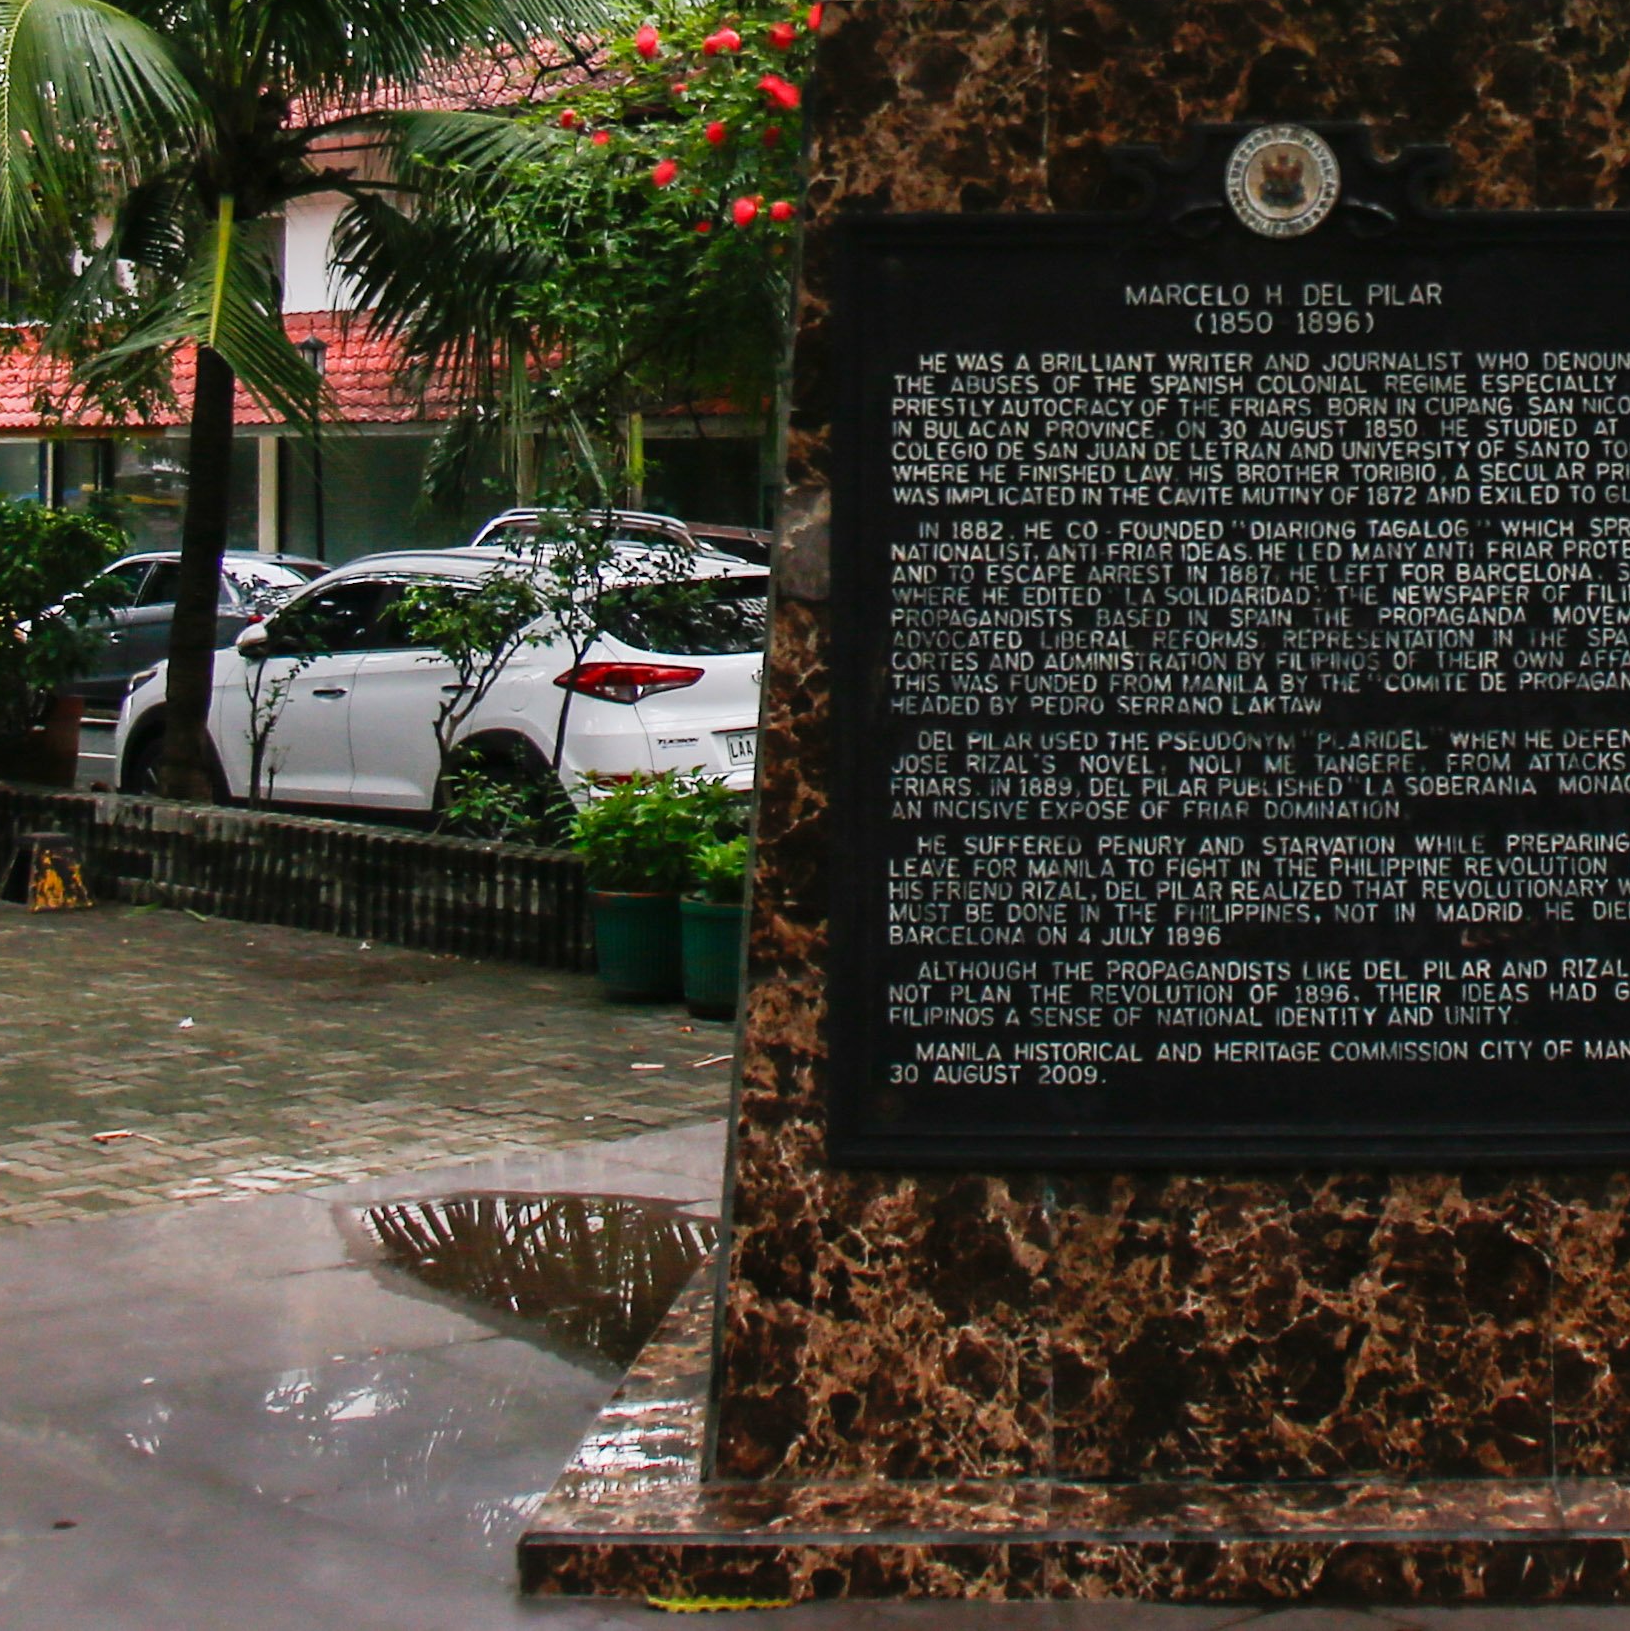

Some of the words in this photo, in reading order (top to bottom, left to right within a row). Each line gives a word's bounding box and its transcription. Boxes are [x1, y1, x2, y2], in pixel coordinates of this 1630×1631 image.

[1125, 284, 1250, 306] MARCELO
[1303, 283, 1352, 305] DEL
[1367, 283, 1443, 305] PILAR
[1296, 311, 1375, 333] 1896)
[918, 353, 948, 374] HE
[955, 353, 1005, 374] WAS
[1014, 352, 1031, 373] A
[1040, 352, 1157, 373] BRILLIANT
[1166, 352, 1254, 373] WRITER
[1264, 352, 1310, 373] AND
[1321, 351, 1463, 372] JOURNALIST
[1476, 351, 1530, 372] WHO
[893, 375, 936, 395] THE
[950, 375, 1040, 395] ABUSES
[1052, 374, 1082, 394] OF
[1093, 374, 1137, 394] THE
[1149, 374, 1244, 394] SPANISH
[1255, 373, 1368, 393] COLONIAL
[1384, 373, 1467, 393] REGIME
[1480, 373, 1617, 393] ESPECIALLY
[891, 398, 996, 418] PRIESTLY
[1000, 397, 1135, 417] AUTOCRACY
[1139, 397, 1169, 417] OF
[1326, 396, 1388, 416] BORN
[1395, 396, 1417, 416] IN
[1527, 396, 1574, 416] SAN
[892, 420, 913, 440] IN
[923, 420, 1030, 440] BULACAN
[1218, 419, 1248, 439] 30
[1259, 419, 1348, 439] AUGUST
[1484, 418, 1578, 438] STUDIED
[1593, 417, 1619, 437] AT
[890, 442, 989, 462] COLEGIO
[996, 442, 1025, 462] DE
[1032, 441, 1078, 461] SAN
[1085, 441, 1146, 461] JUAN
[1153, 441, 1182, 461] DE
[1189, 441, 1282, 461] LETRAN
[1289, 440, 1334, 460] AND
[1340, 440, 1471, 460] UNIVERSITY
[1476, 440, 1506, 460] OF
[1514, 440, 1591, 460] SANTO
[891, 464, 970, 484] WHERE
[978, 464, 1007, 484] HE
[1017, 463, 1117, 483] FINISHED
[1188, 463, 1224, 483] HIS
[1235, 463, 1340, 483] BROTHER
[1454, 462, 1471, 482] A
[1478, 462, 1586, 482] SECULAR
[892, 487, 940, 507] WAS
[945, 487, 1076, 507] IMPLICATED
[1081, 486, 1103, 506] IN
[1108, 486, 1151, 506] THE
[1156, 486, 1234, 506] CAVITE
[1241, 486, 1325, 506] MUTINY
[1330, 485, 1360, 505] OF
[1366, 485, 1418, 505] 1872
[1425, 485, 1471, 505] AND
[1478, 485, 1561, 505] EXILED
[1568, 485, 1597, 505] TO
[1500, 518, 1575, 539] WHICH
[891, 674, 941, 694] THIS
[950, 674, 999, 694] WAS
[1009, 673, 1098, 693] FUNDED
[1109, 673, 1172, 693] FROM
[1181, 673, 1269, 693] MANILA
[1279, 673, 1308, 693] BY
[890, 696, 980, 716] HEADED
[989, 696, 1018, 716] BY
[1030, 695, 1105, 715] PEDRO
[1116, 695, 1224, 715] SERRANO
[1231, 695, 1322, 715] LAKTAW
[731, 740, 754, 758] LAA
[963, 834, 1083, 855] SUFFERED
[1097, 834, 1187, 855] PENURY
[1198, 834, 1245, 855] AND
[1261, 833, 1396, 854] STARVATION
[1505, 833, 1630, 854] PREPARING
[888, 858, 961, 879] LEAVE
[1027, 857, 1116, 878] MANILA
[1165, 857, 1231, 878] FIGHT
[1329, 856, 1452, 877] PHILIPPINE
[1464, 856, 1608, 877] REVOLUTION
[1021, 879, 1097, 901] RIZAL,
[1105, 879, 1148, 901] DEL
[1156, 879, 1223, 901] PILAR
[1229, 879, 1343, 901] REALIZED
[1351, 878, 1409, 900] THAT
[1421, 878, 1609, 900] REVOLUTIONARY
[965, 903, 994, 924] BE
[1006, 902, 1068, 923] DONE
[1114, 902, 1158, 923] THE
[1334, 901, 1379, 922] NOT
[888, 925, 1025, 946] BARCELONA
[1037, 924, 1068, 945] ON
[1077, 924, 1091, 945] 4
[1101, 924, 1155, 945] JULY
[917, 960, 1037, 982] ALTHOUGH
[1106, 959, 1291, 981] PROPAGANDISTS
[1302, 958, 1352, 980] LIKE
[1363, 958, 1409, 980] DEL
[1423, 958, 1492, 980] PILAR
[1501, 958, 1548, 980] AND
[1561, 957, 1630, 979] RIZAL
[888, 984, 932, 1005] NOT
[950, 984, 1012, 1005] PLAN
[1029, 983, 1073, 1004] THE
[1090, 983, 1233, 1004] REVOLUTION
[1248, 983, 1279, 1004] OF
[1375, 982, 1442, 1003] THEIR
[1461, 982, 1530, 1003] IDEAS
[1549, 982, 1597, 1003] HAD
[888, 1007, 995, 1028] FILIPINOS
[1004, 1007, 1021, 1028] A
[1113, 1006, 1143, 1027] OF
[1156, 1006, 1263, 1027] NATIONAL
[1275, 1005, 1378, 1026] IDENTITY
[1387, 1005, 1434, 1026] AND
[915, 1042, 1003, 1063] MANILA
[1014, 1041, 1143, 1062] HISTORICAL
[1156, 1041, 1202, 1062] AND
[1214, 1041, 1321, 1062] HERITAGE
[1329, 1040, 1469, 1061] COMMISSION
[1479, 1040, 1533, 1061] CITY
[1543, 1040, 1574, 1061] OF
[889, 1065, 919, 1085] 30
[932, 1065, 1022, 1085] AUGUST
[1038, 1064, 1107, 1084] 2009.
